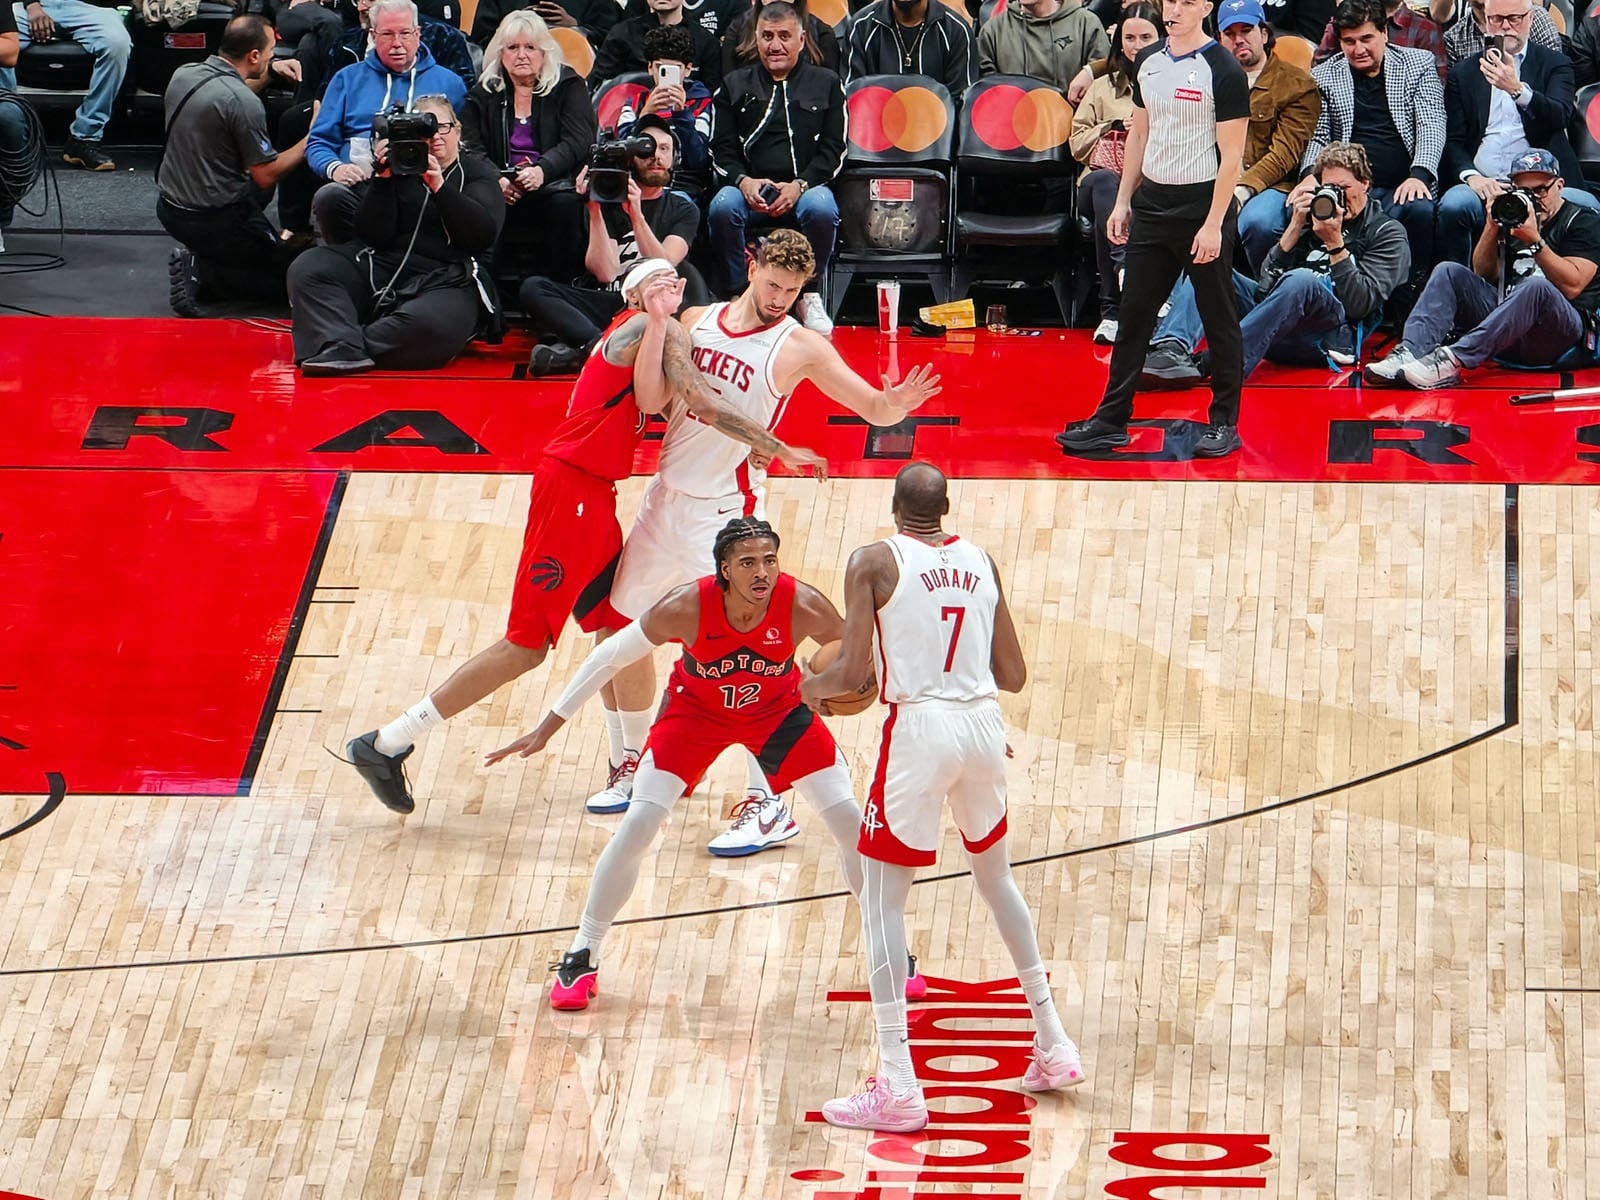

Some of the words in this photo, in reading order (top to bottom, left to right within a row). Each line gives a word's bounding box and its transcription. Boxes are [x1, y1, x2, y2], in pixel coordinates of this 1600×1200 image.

[691, 346, 755, 393] OCKETS
[920, 567, 981, 595] DURANT
[941, 606, 966, 673] 7
[696, 654, 787, 679] RAPTORS
[719, 682, 771, 710] 12
